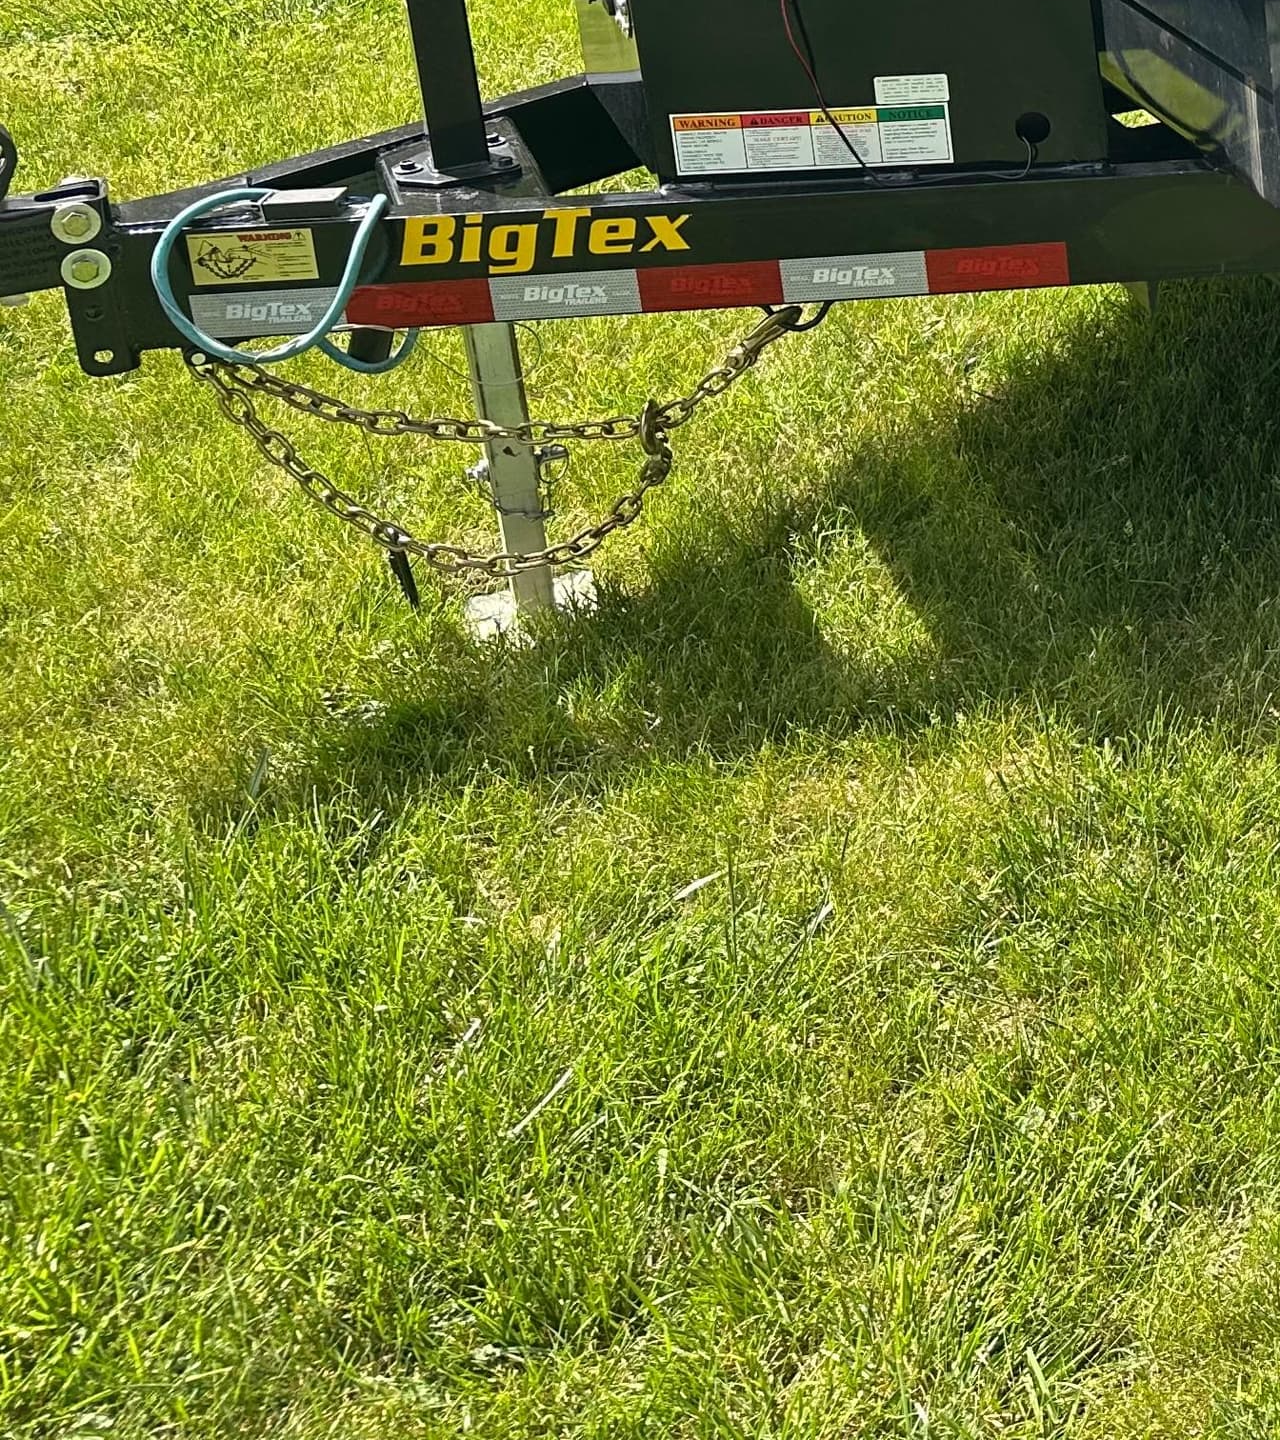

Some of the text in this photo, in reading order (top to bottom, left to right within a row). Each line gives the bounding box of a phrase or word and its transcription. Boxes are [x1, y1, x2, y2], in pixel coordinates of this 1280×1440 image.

[680, 118, 736, 128] WARNING
[760, 116, 802, 124] DANGER
[400, 208, 692, 274] BigTex
[812, 265, 895, 285] BigTex
[852, 277, 894, 288] TRAILERS
[524, 284, 607, 304] BigTex
[564, 296, 608, 306] TRAILERS
[226, 302, 312, 322] BigTex
